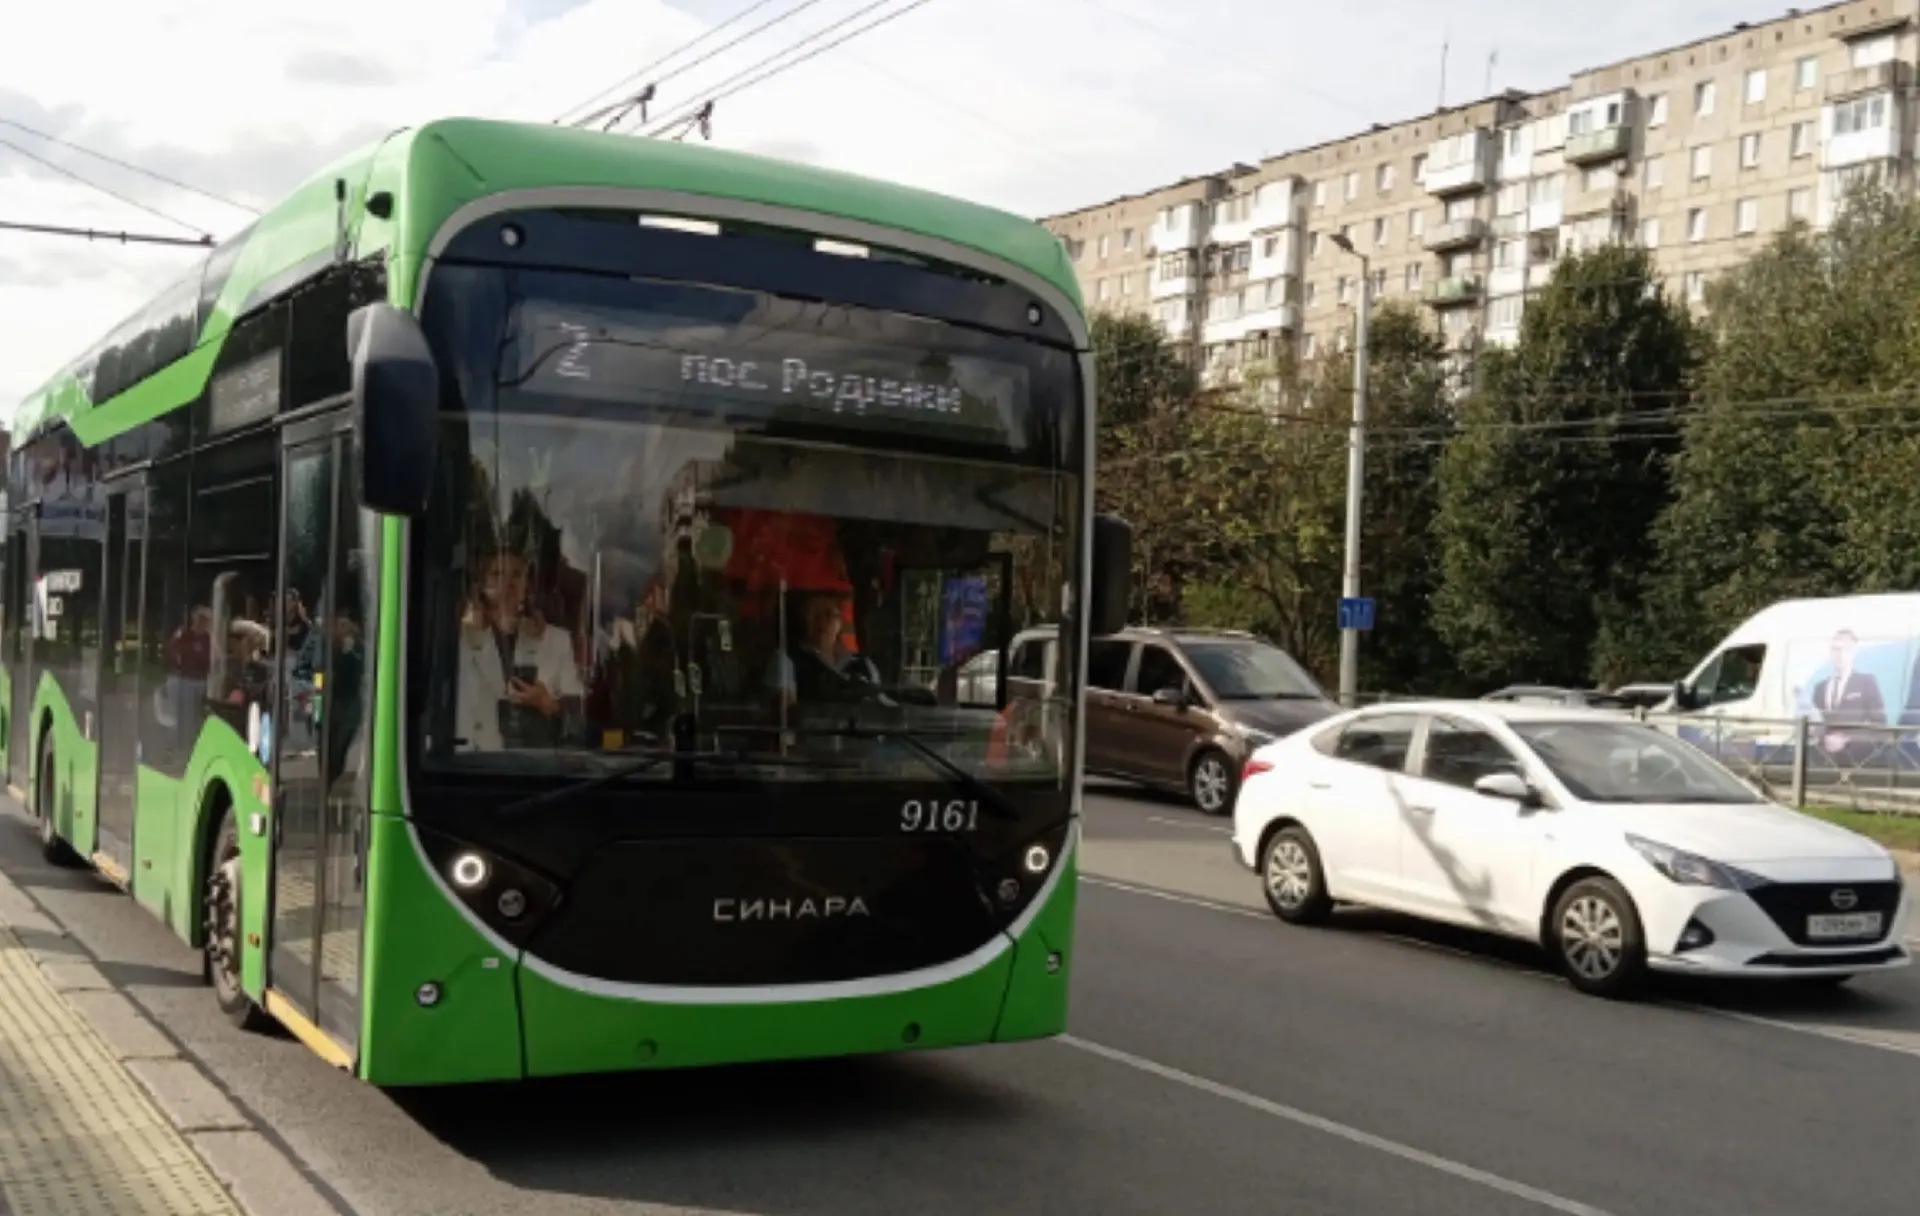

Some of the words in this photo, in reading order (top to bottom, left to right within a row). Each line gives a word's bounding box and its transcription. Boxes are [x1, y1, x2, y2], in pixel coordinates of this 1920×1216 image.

[555, 321, 591, 380] 2
[681, 354, 769, 391] пос
[900, 799, 979, 832] 9161
[713, 895, 871, 921] СИНАРА
